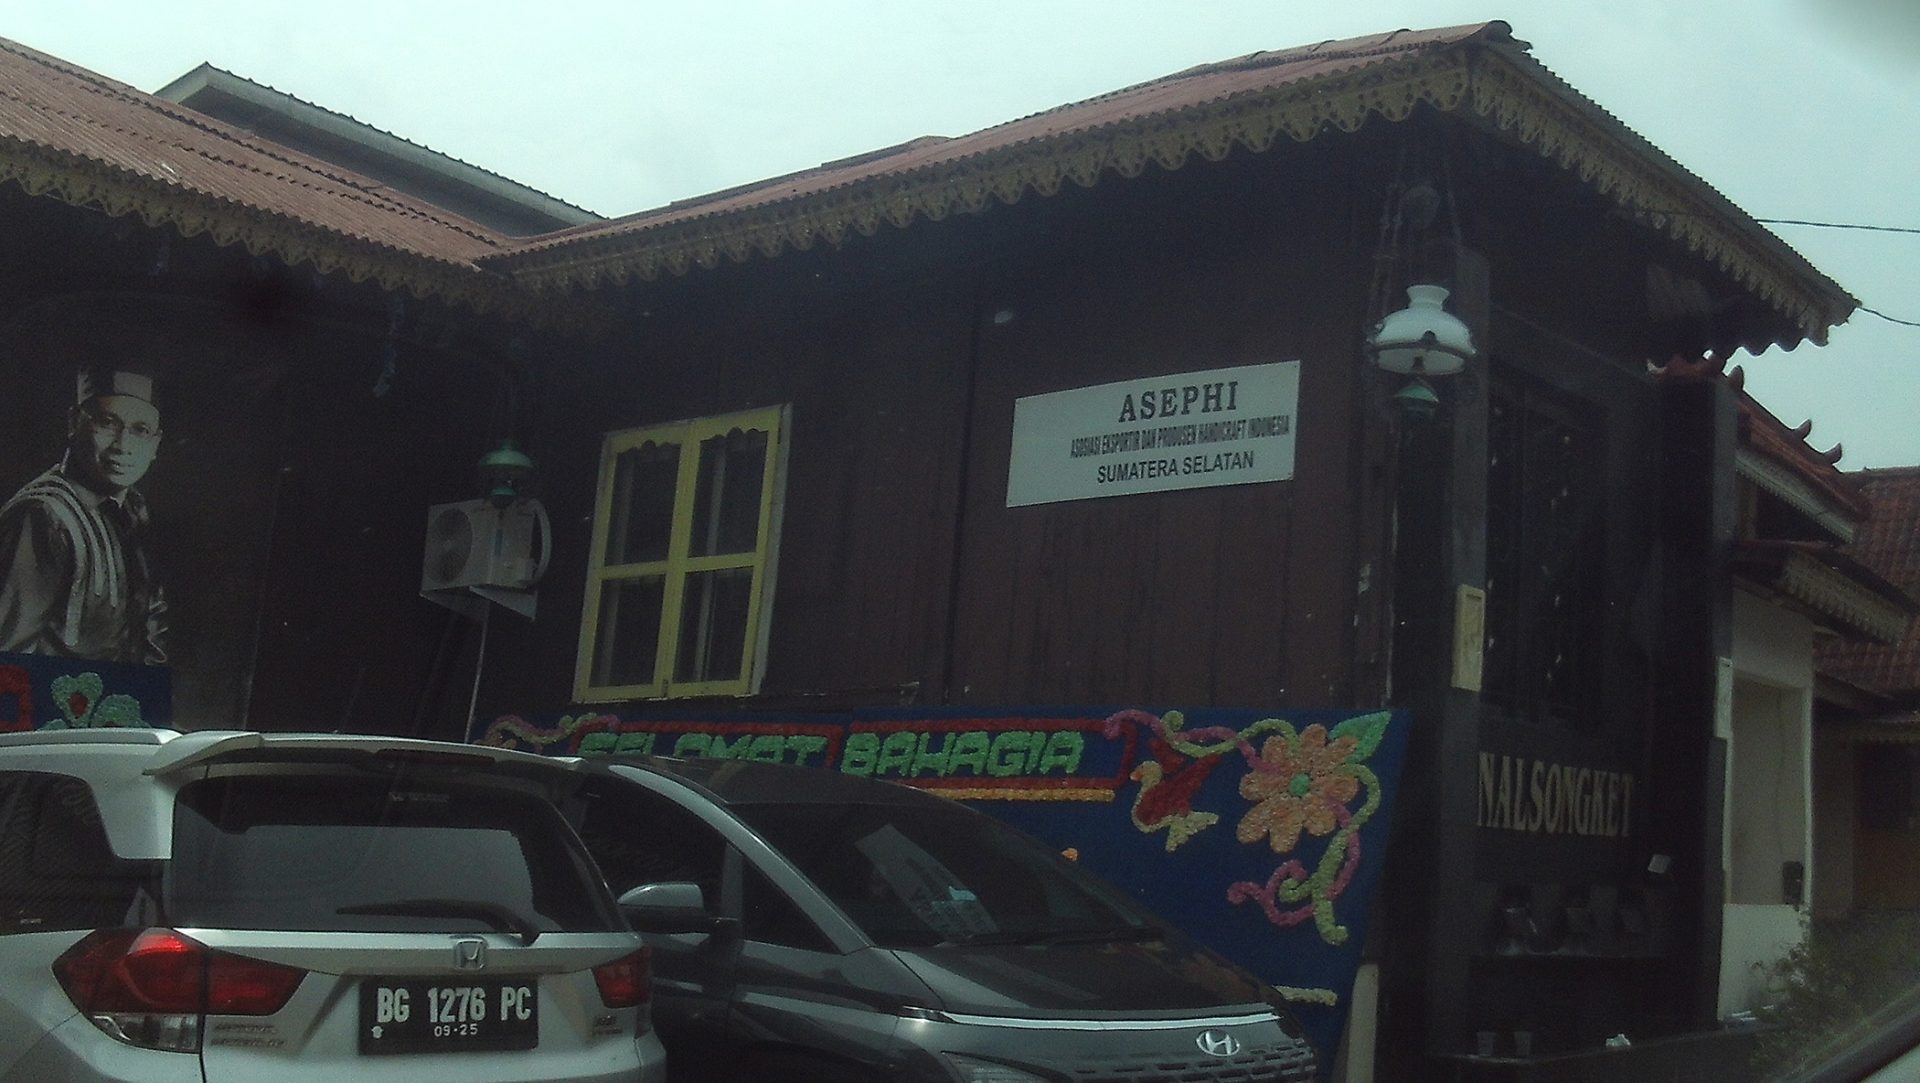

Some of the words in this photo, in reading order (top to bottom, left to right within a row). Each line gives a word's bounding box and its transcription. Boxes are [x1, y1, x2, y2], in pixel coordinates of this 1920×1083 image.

[1118, 381, 1239, 423] ASEPHI
[1101, 430, 1140, 455] EKSPORTIR
[1141, 428, 1157, 450] DAN
[1158, 424, 1197, 448] PRODUSEN
[1198, 419, 1246, 444] HANDICRAFT
[1247, 415, 1289, 438] INDONESIA
[1097, 457, 1178, 483] SUMATERA
[1182, 451, 1254, 475] SELATAN
[841, 729, 1084, 778] BAHAGIA
[377, 987, 410, 1023] BG
[427, 987, 486, 1023] 1276
[500, 987, 531, 1021] PC
